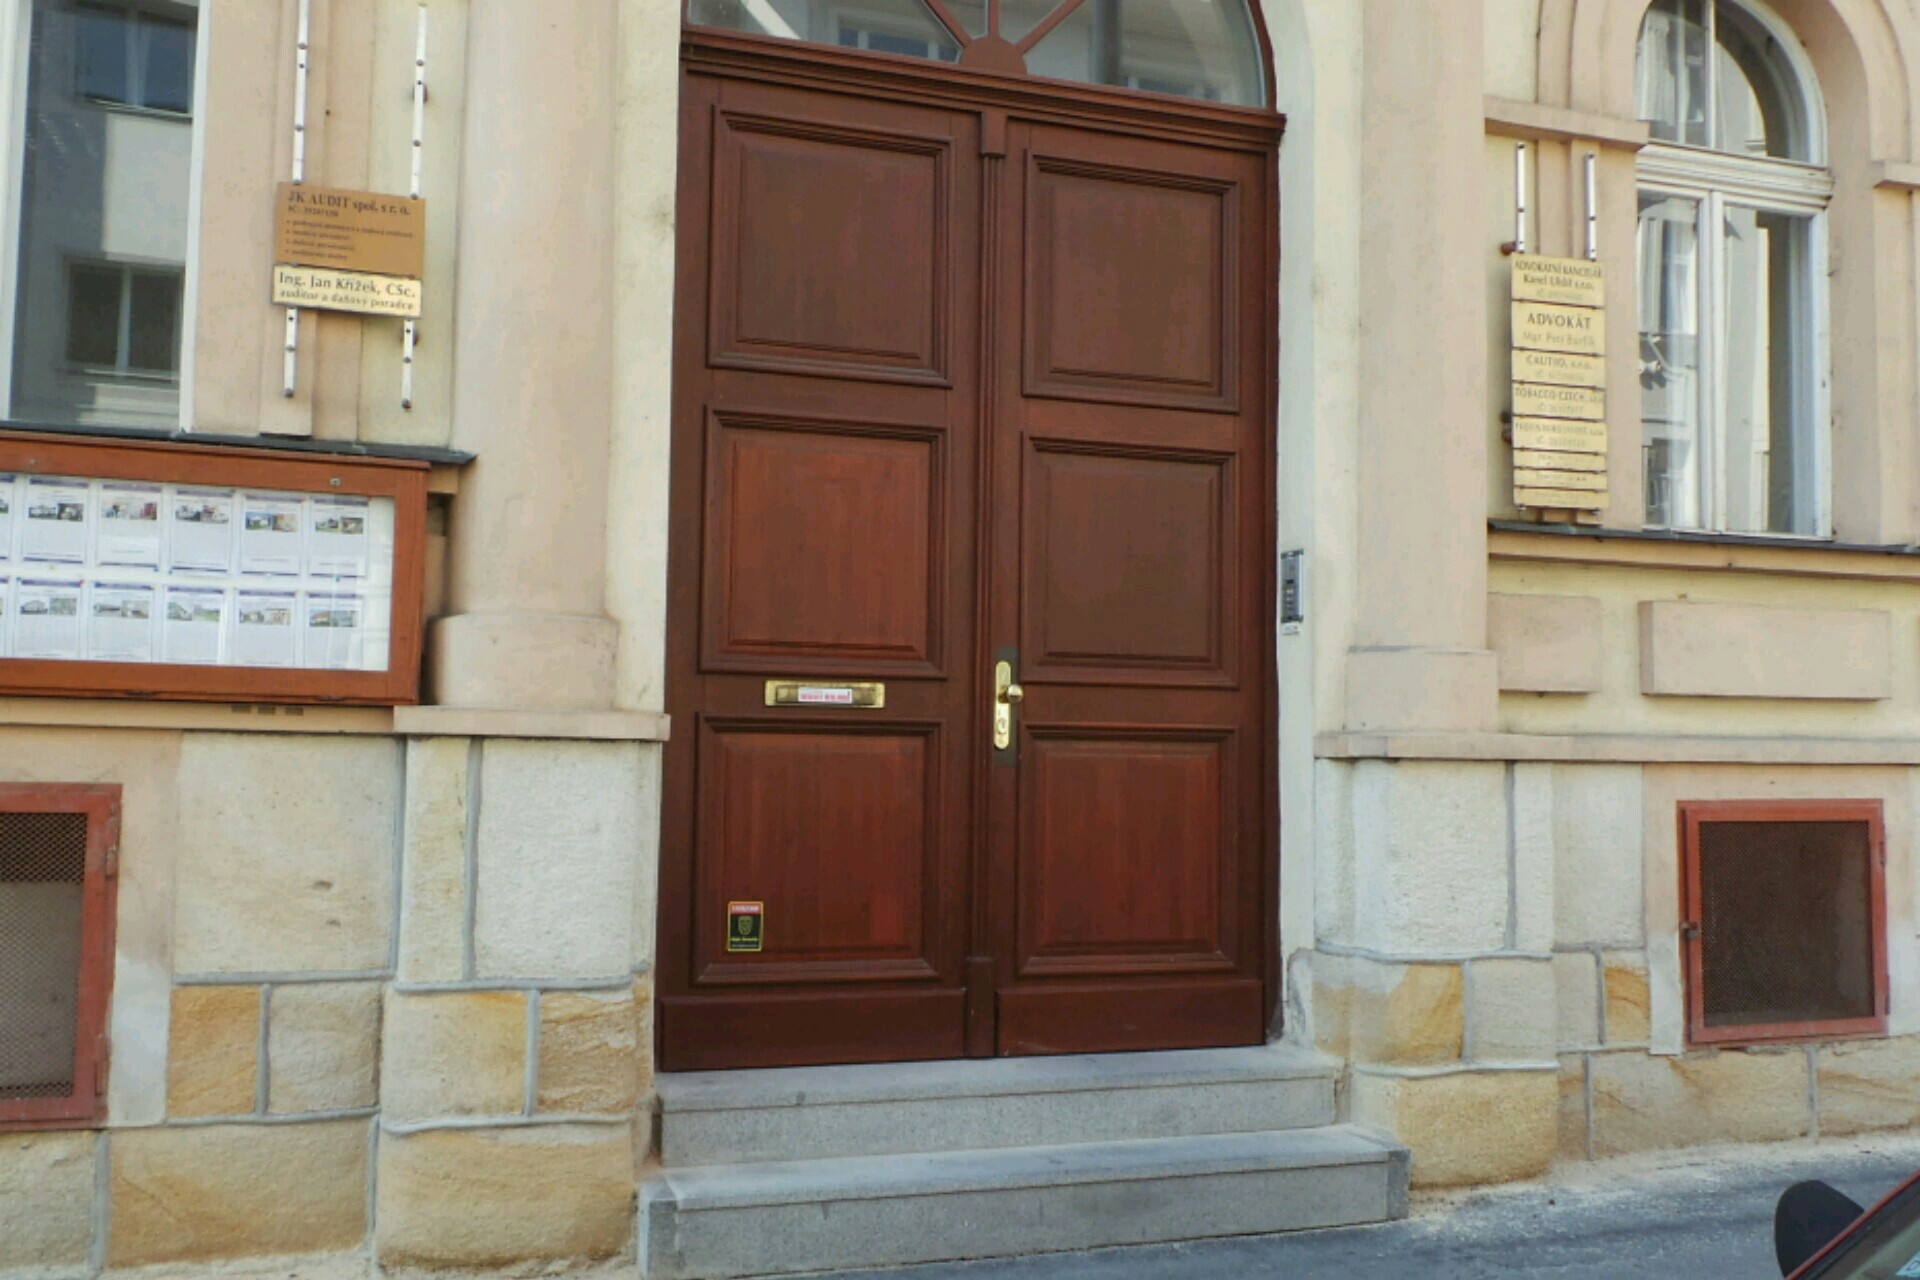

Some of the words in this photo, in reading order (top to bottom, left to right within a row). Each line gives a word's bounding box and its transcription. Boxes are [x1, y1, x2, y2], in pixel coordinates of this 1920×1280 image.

[288, 191, 305, 203] JK
[311, 193, 348, 209] AUDIT
[279, 272, 306, 287] Ing.
[310, 275, 331, 289] Jan
[336, 277, 381, 295] Křížek,
[385, 282, 416, 298] CSc.
[280, 287, 319, 300] auditor
[321, 294, 329, 302] a
[370, 298, 414, 311] poradce
[1527, 312, 1592, 330] ADVOKÁT
